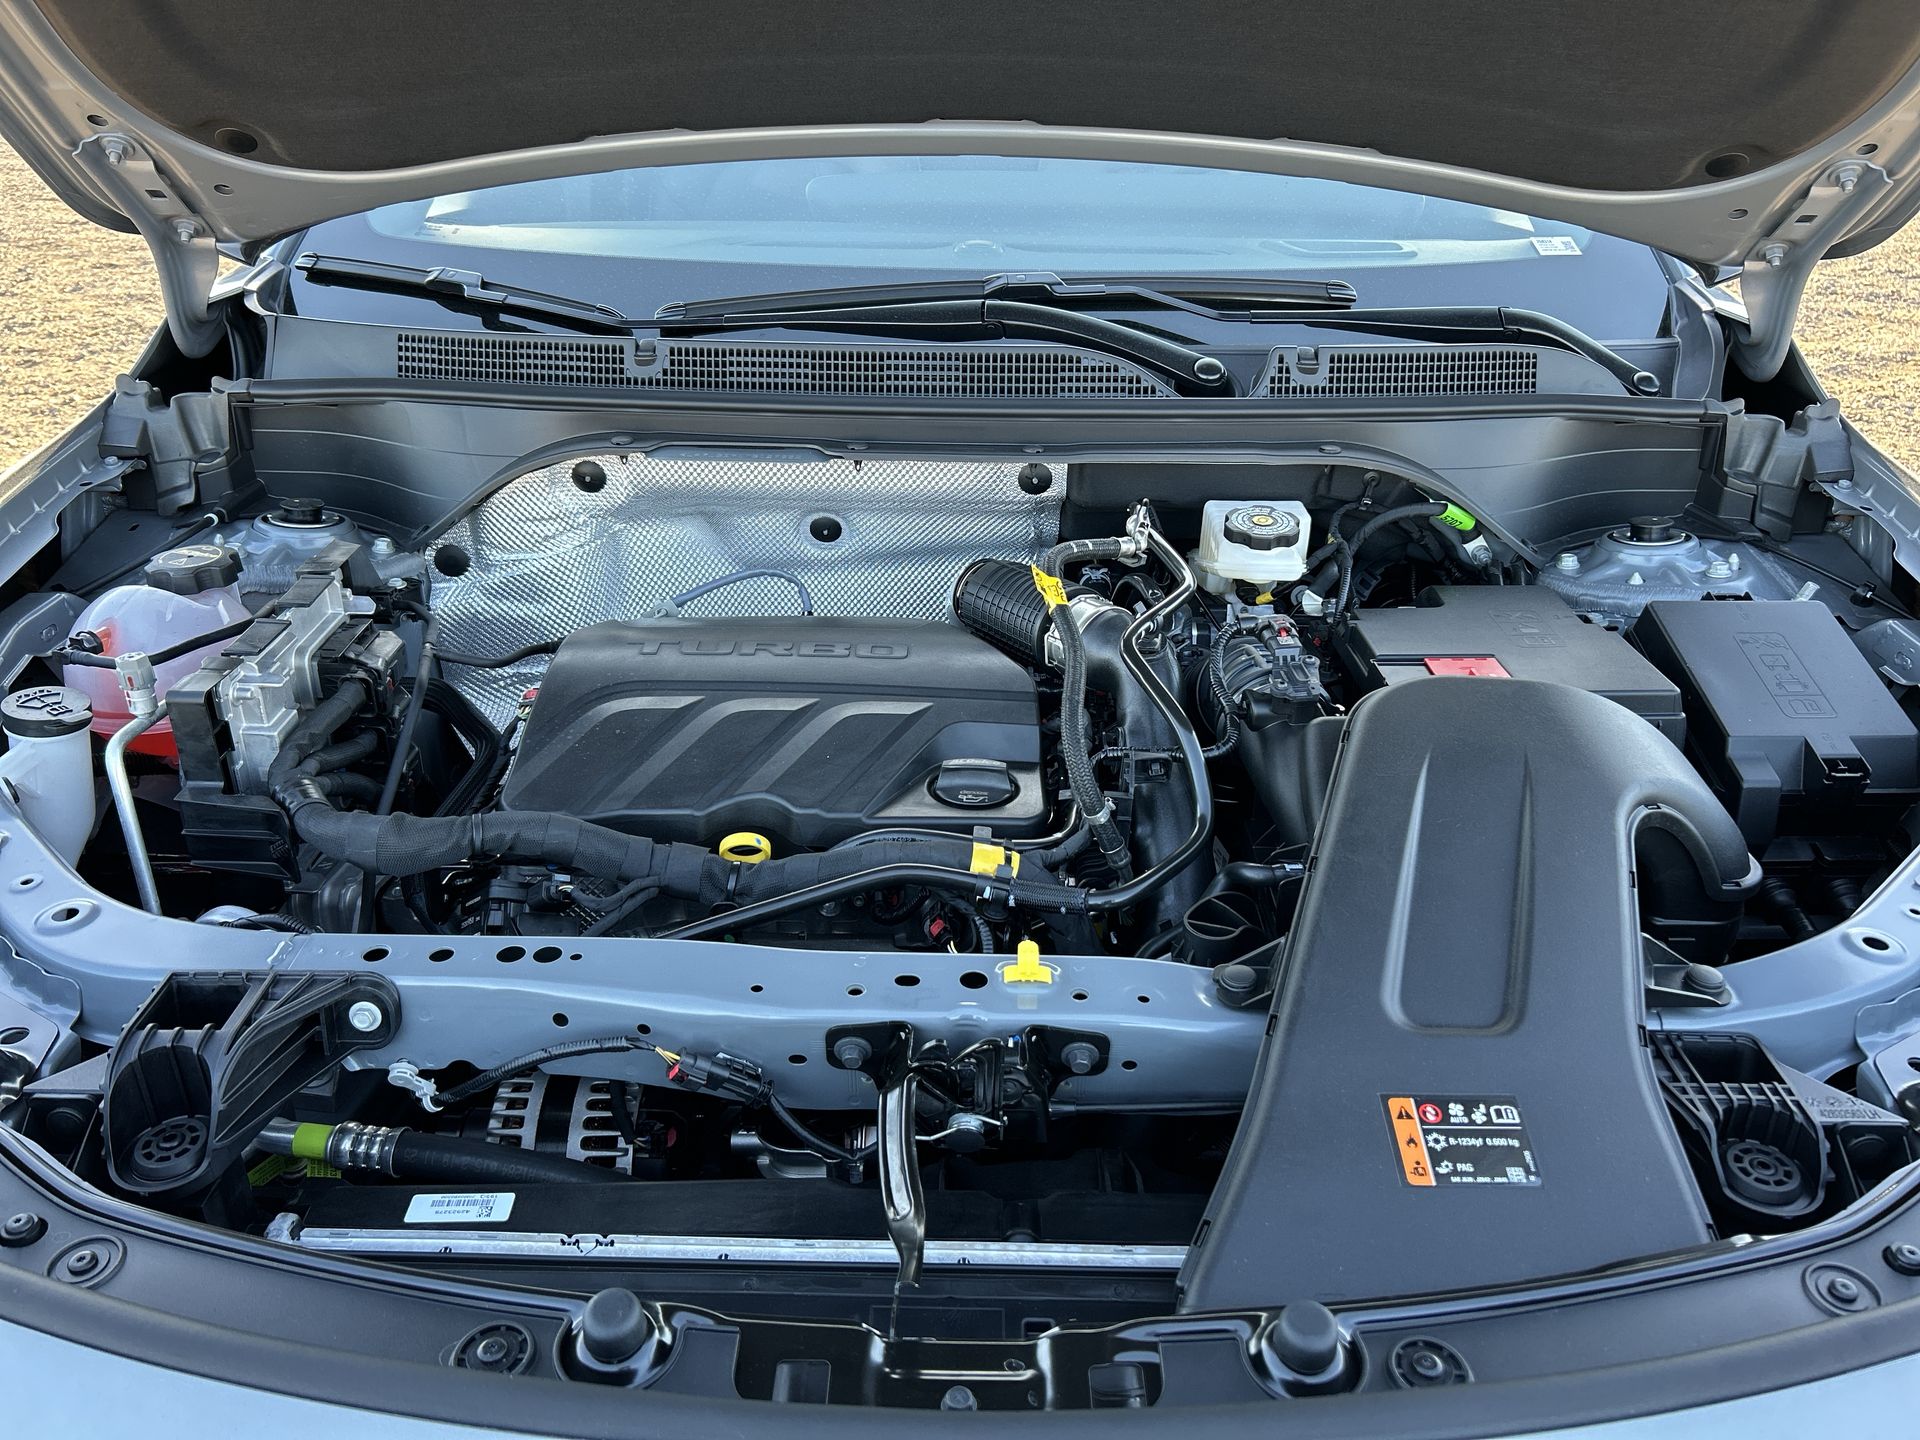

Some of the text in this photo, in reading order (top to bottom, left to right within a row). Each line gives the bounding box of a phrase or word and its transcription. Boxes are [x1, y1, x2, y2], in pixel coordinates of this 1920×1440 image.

[627, 640, 910, 660] TURBO
[1448, 1137, 1483, 1148] R-1234yf
[1508, 1137, 1520, 1148] kg
[1456, 1163, 1474, 1173] PAG
